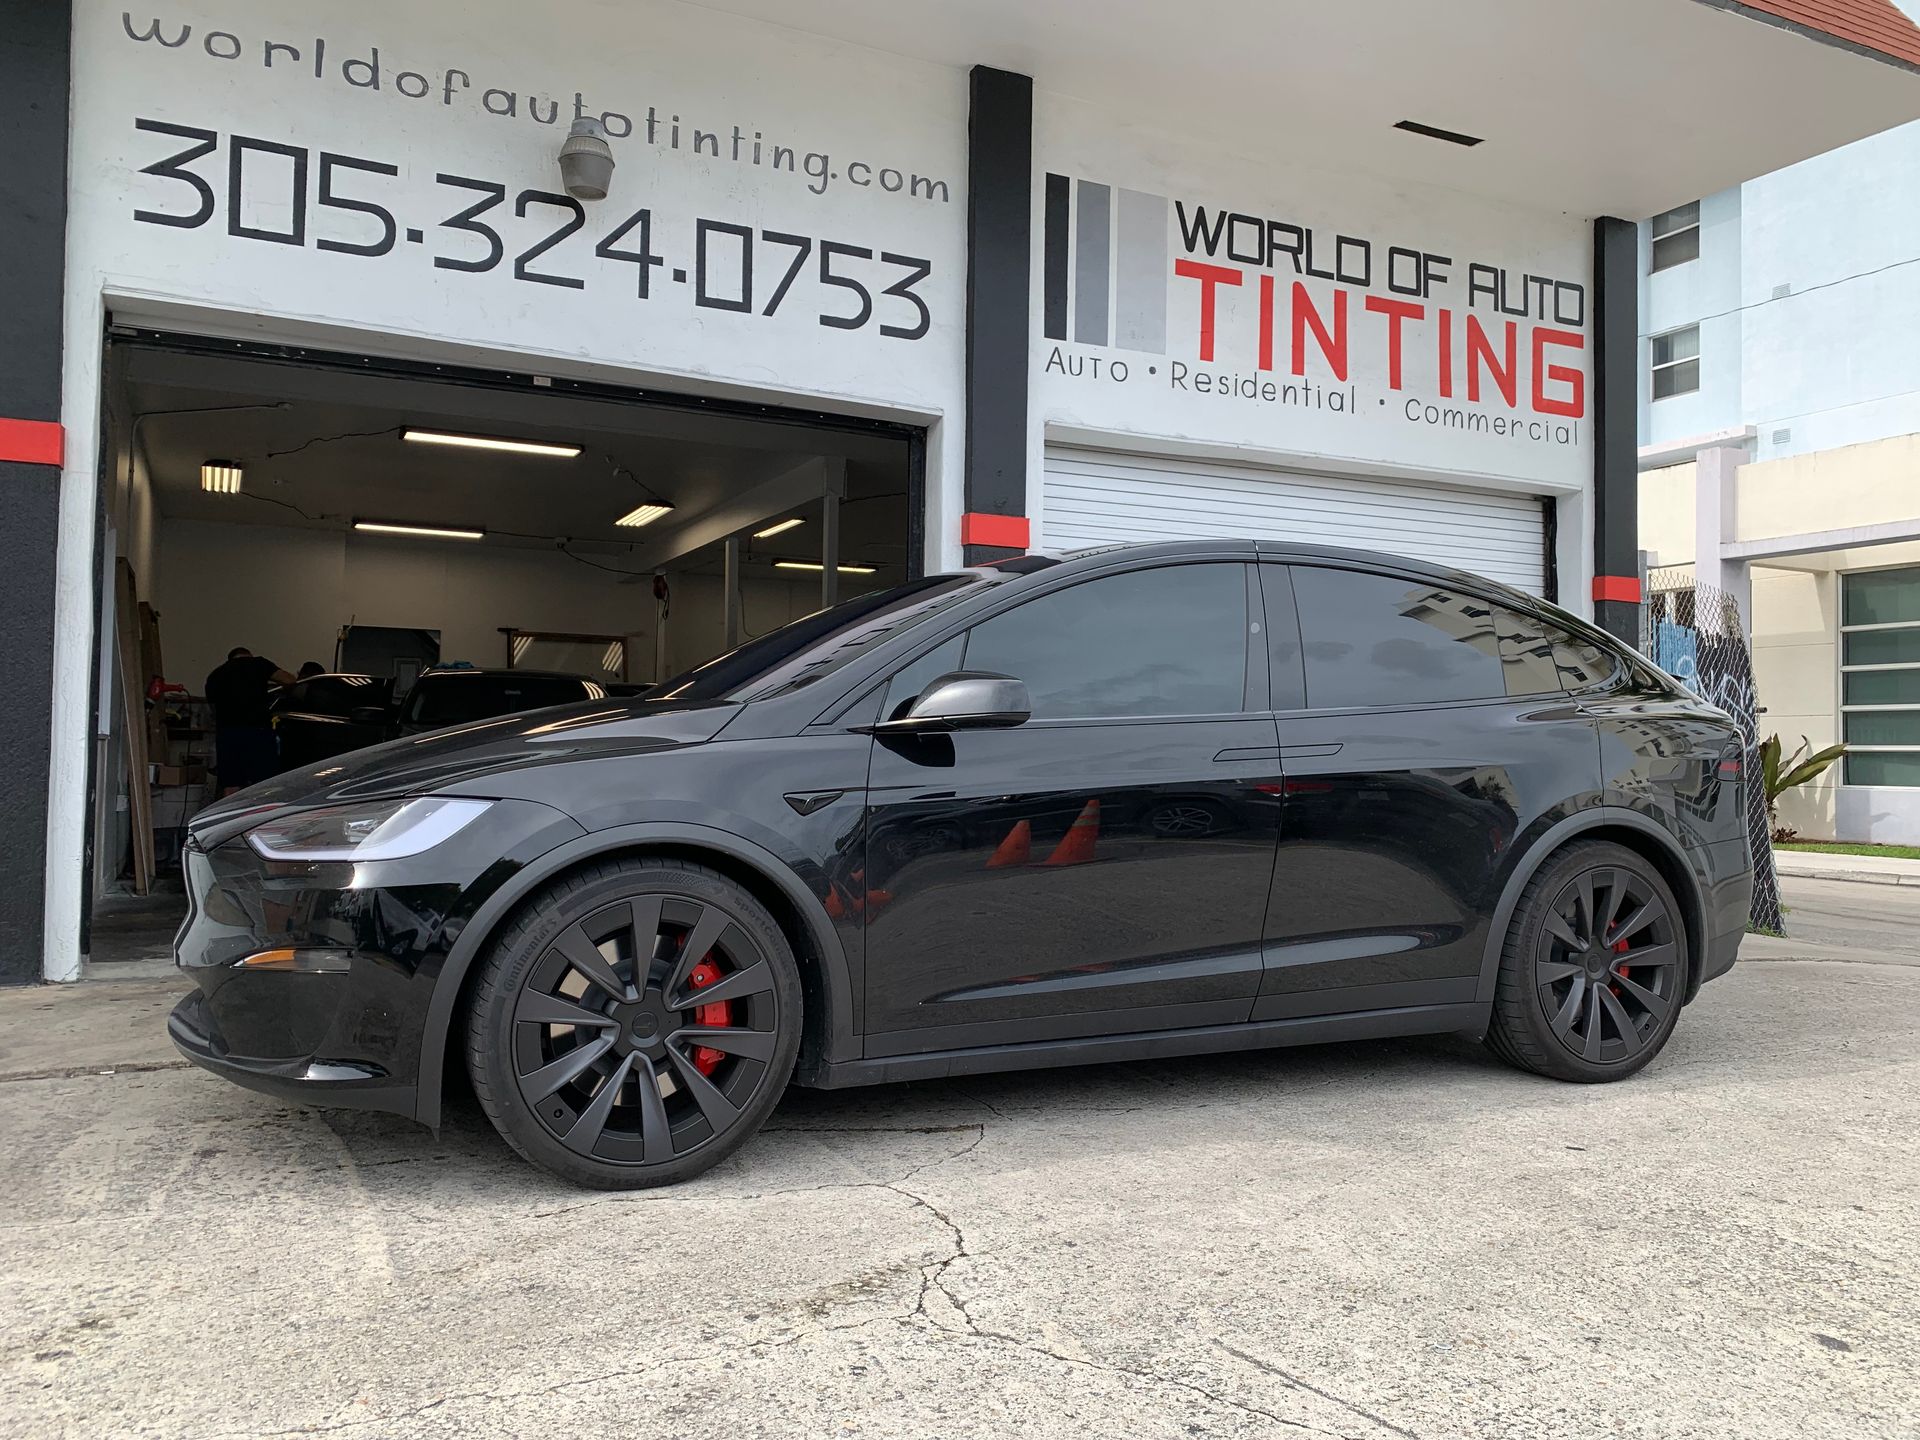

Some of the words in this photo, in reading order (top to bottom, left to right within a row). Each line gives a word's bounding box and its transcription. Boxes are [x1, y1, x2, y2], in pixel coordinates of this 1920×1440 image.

[122, 12, 949, 202] worldofautotinting.com
[133, 117, 931, 340] 305.324.0753
[1174, 199, 1371, 287] WORLD
[1388, 246, 1452, 298] OF
[1468, 263, 1584, 327] AUTO
[1171, 360, 1356, 414] Residential
[1404, 398, 1579, 446] Commercial
[1174, 258, 1584, 418] TINTING
